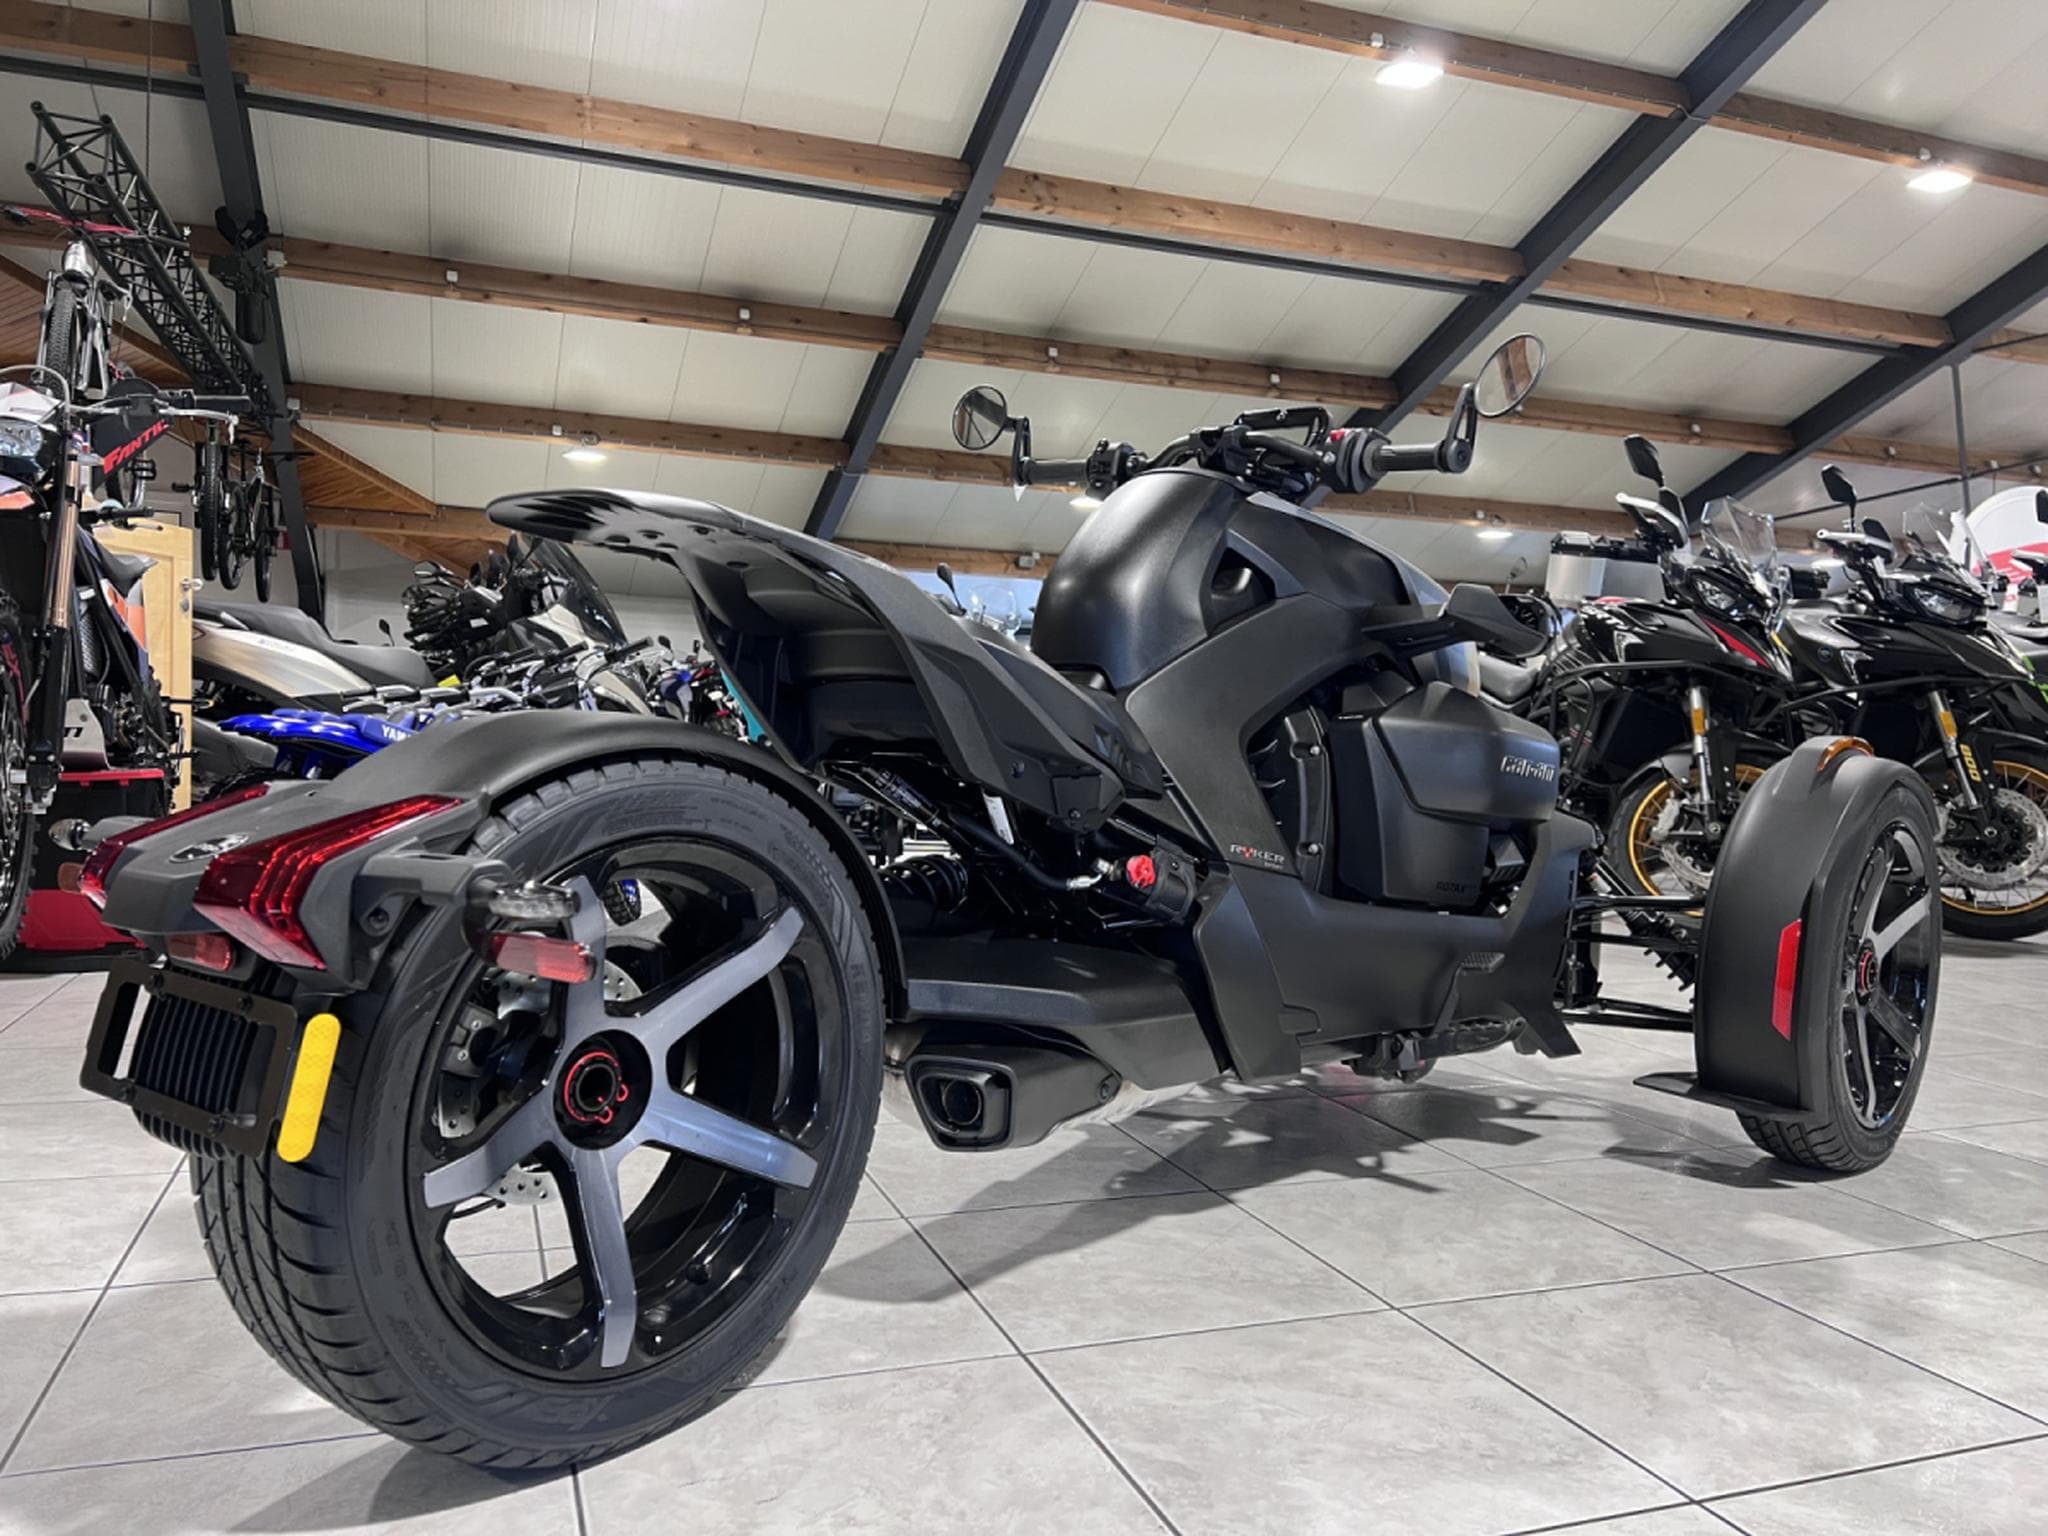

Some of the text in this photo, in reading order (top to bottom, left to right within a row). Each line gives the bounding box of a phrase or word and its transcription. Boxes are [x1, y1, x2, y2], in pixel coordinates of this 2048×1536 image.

[103, 418, 169, 474] FANTIC
[382, 724, 412, 742] YAM
[1230, 844, 1285, 865] RYKER
